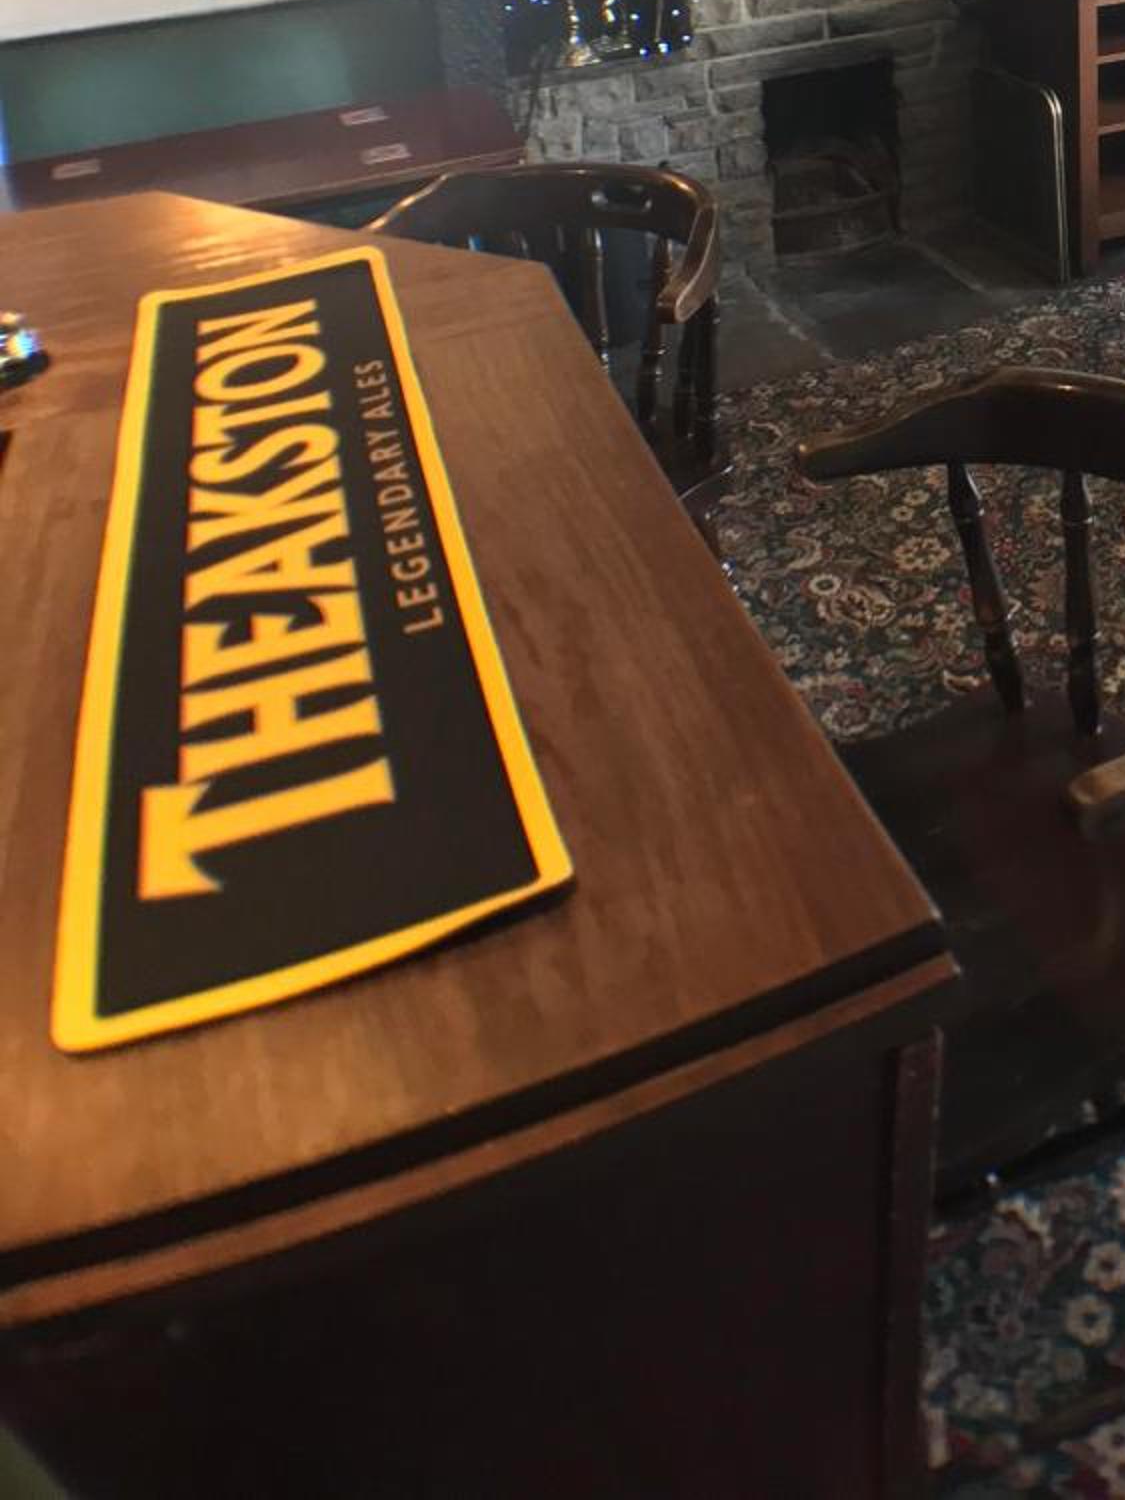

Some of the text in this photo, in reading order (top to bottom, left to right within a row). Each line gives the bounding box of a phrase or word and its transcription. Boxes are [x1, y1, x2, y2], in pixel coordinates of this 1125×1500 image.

[138, 298, 396, 901] THEAKSTON
[354, 357, 445, 635] LEGENDARY ALES
